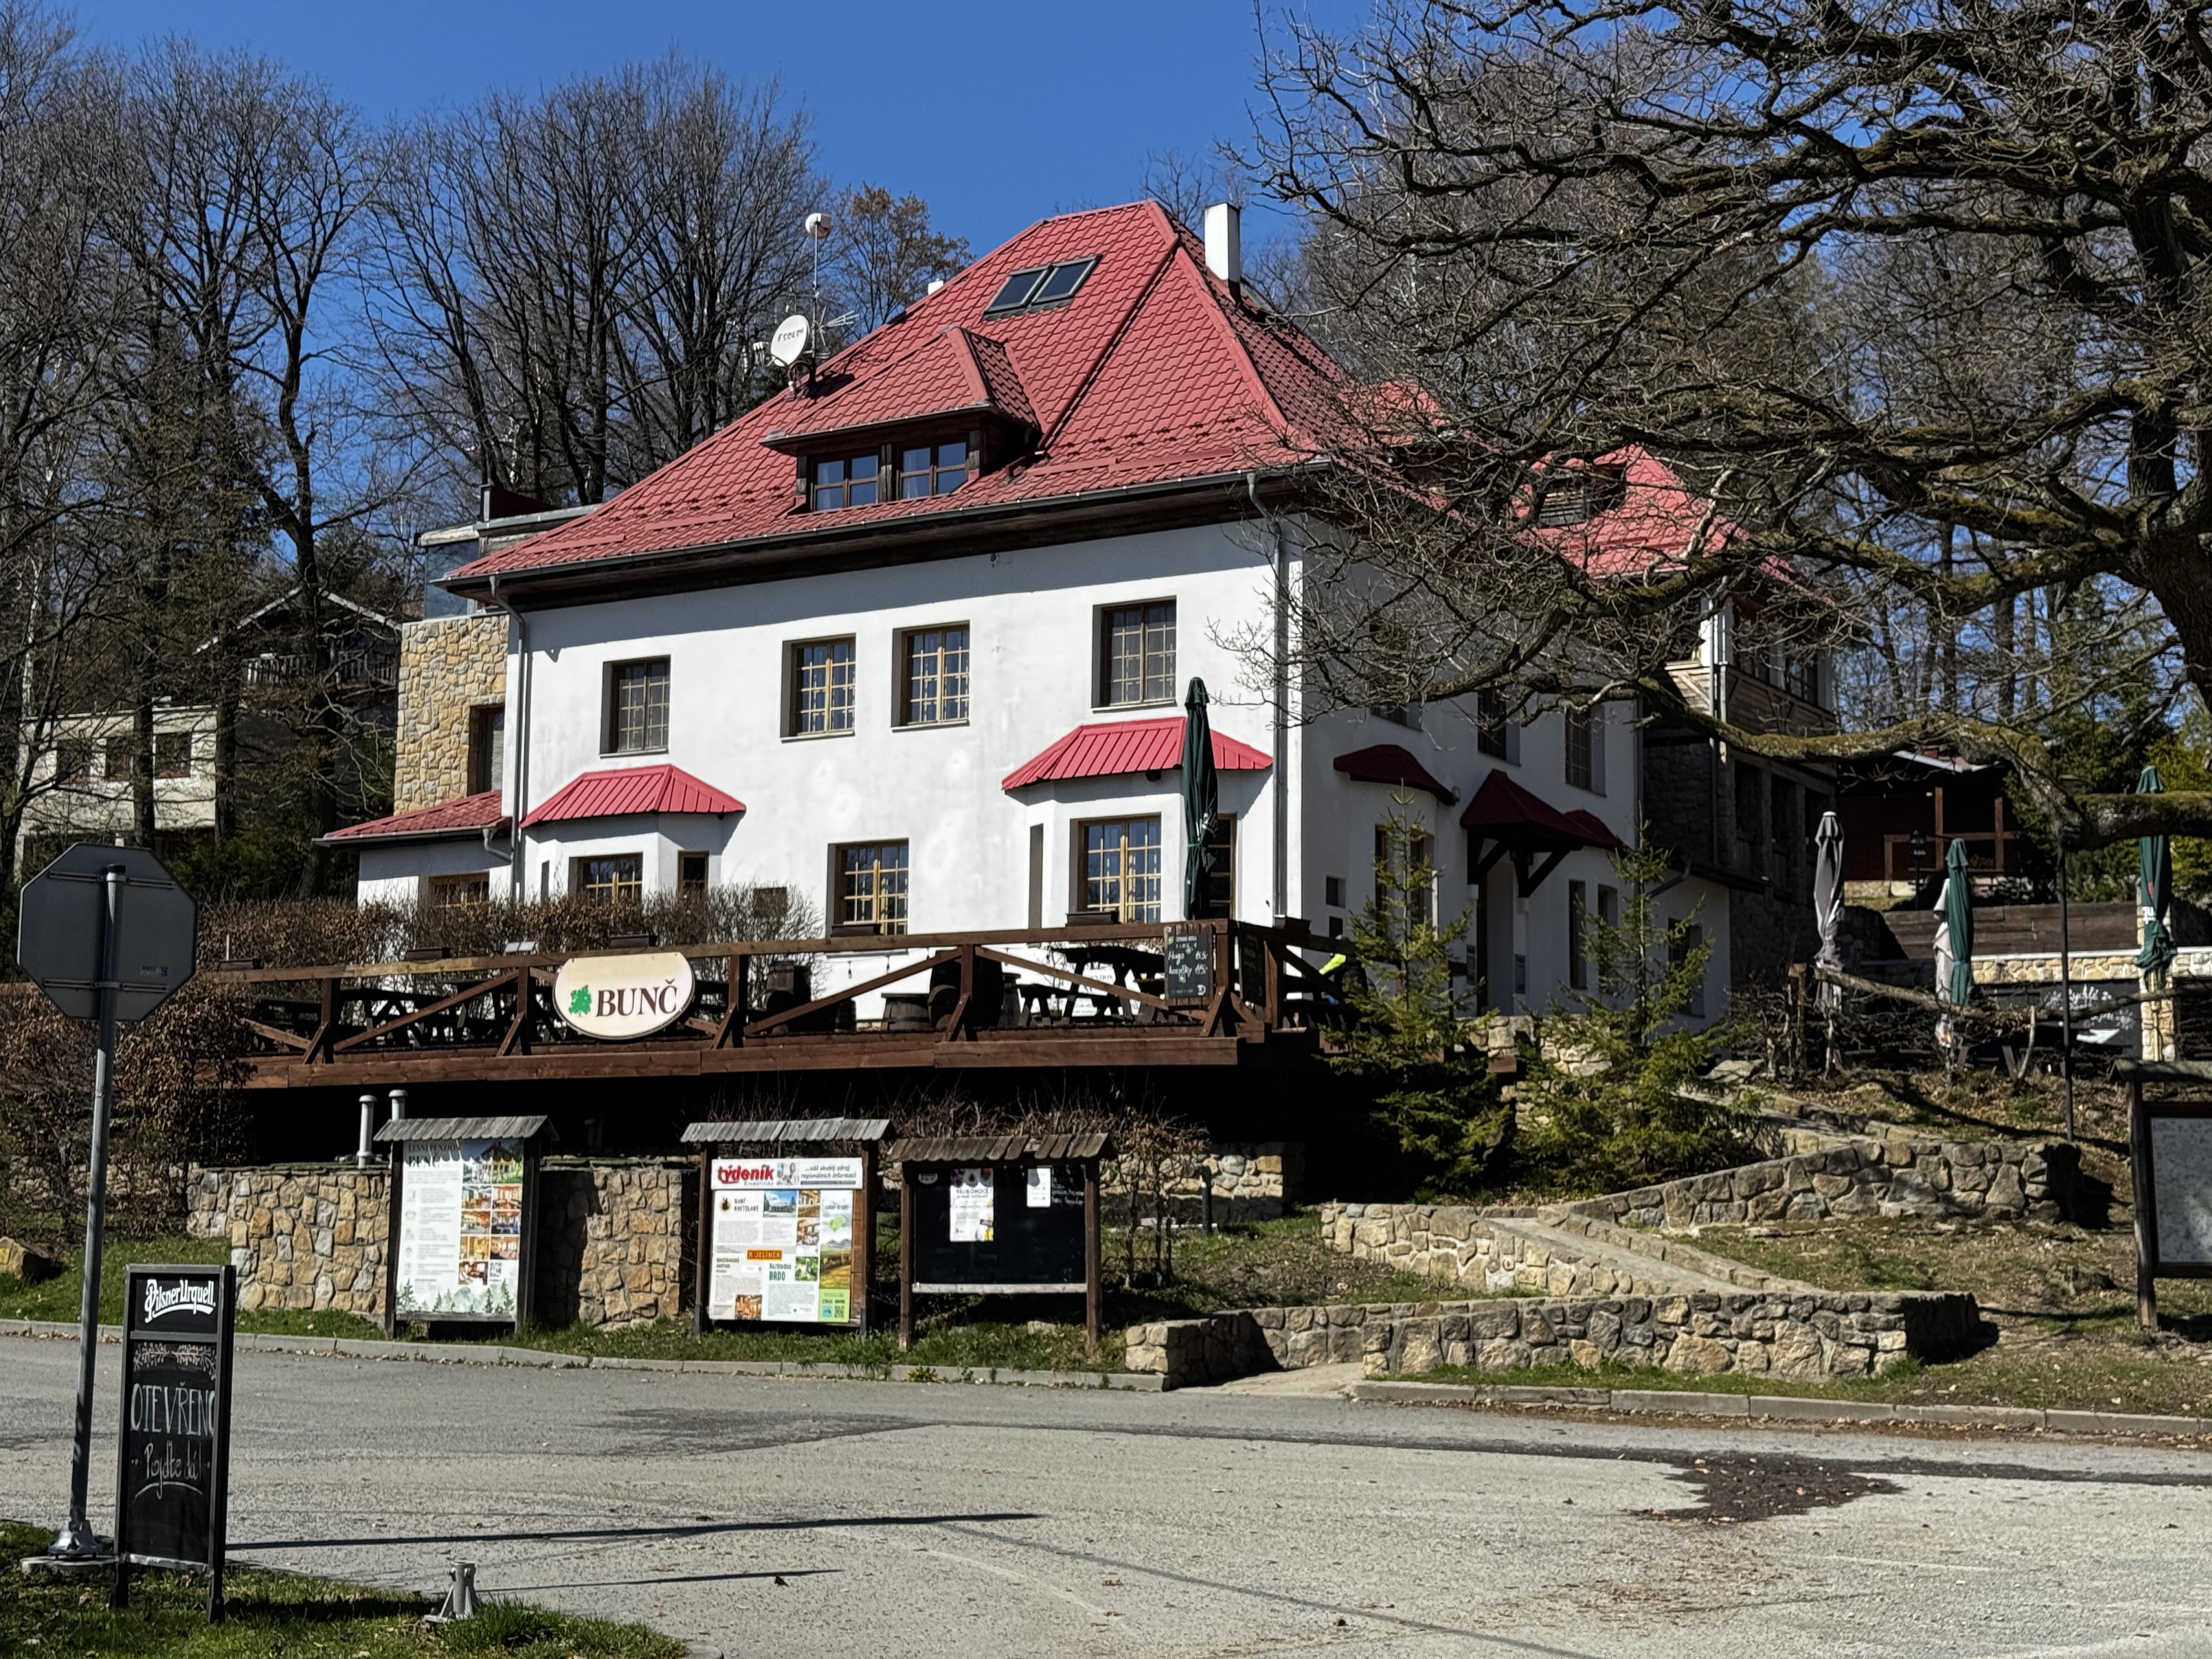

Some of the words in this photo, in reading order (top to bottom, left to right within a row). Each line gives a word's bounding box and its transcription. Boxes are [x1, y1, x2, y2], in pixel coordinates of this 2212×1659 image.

[596, 978, 678, 1018] BUNČ
[718, 1164, 774, 1185] týdeník
[144, 1279, 181, 1323] Pilsner
